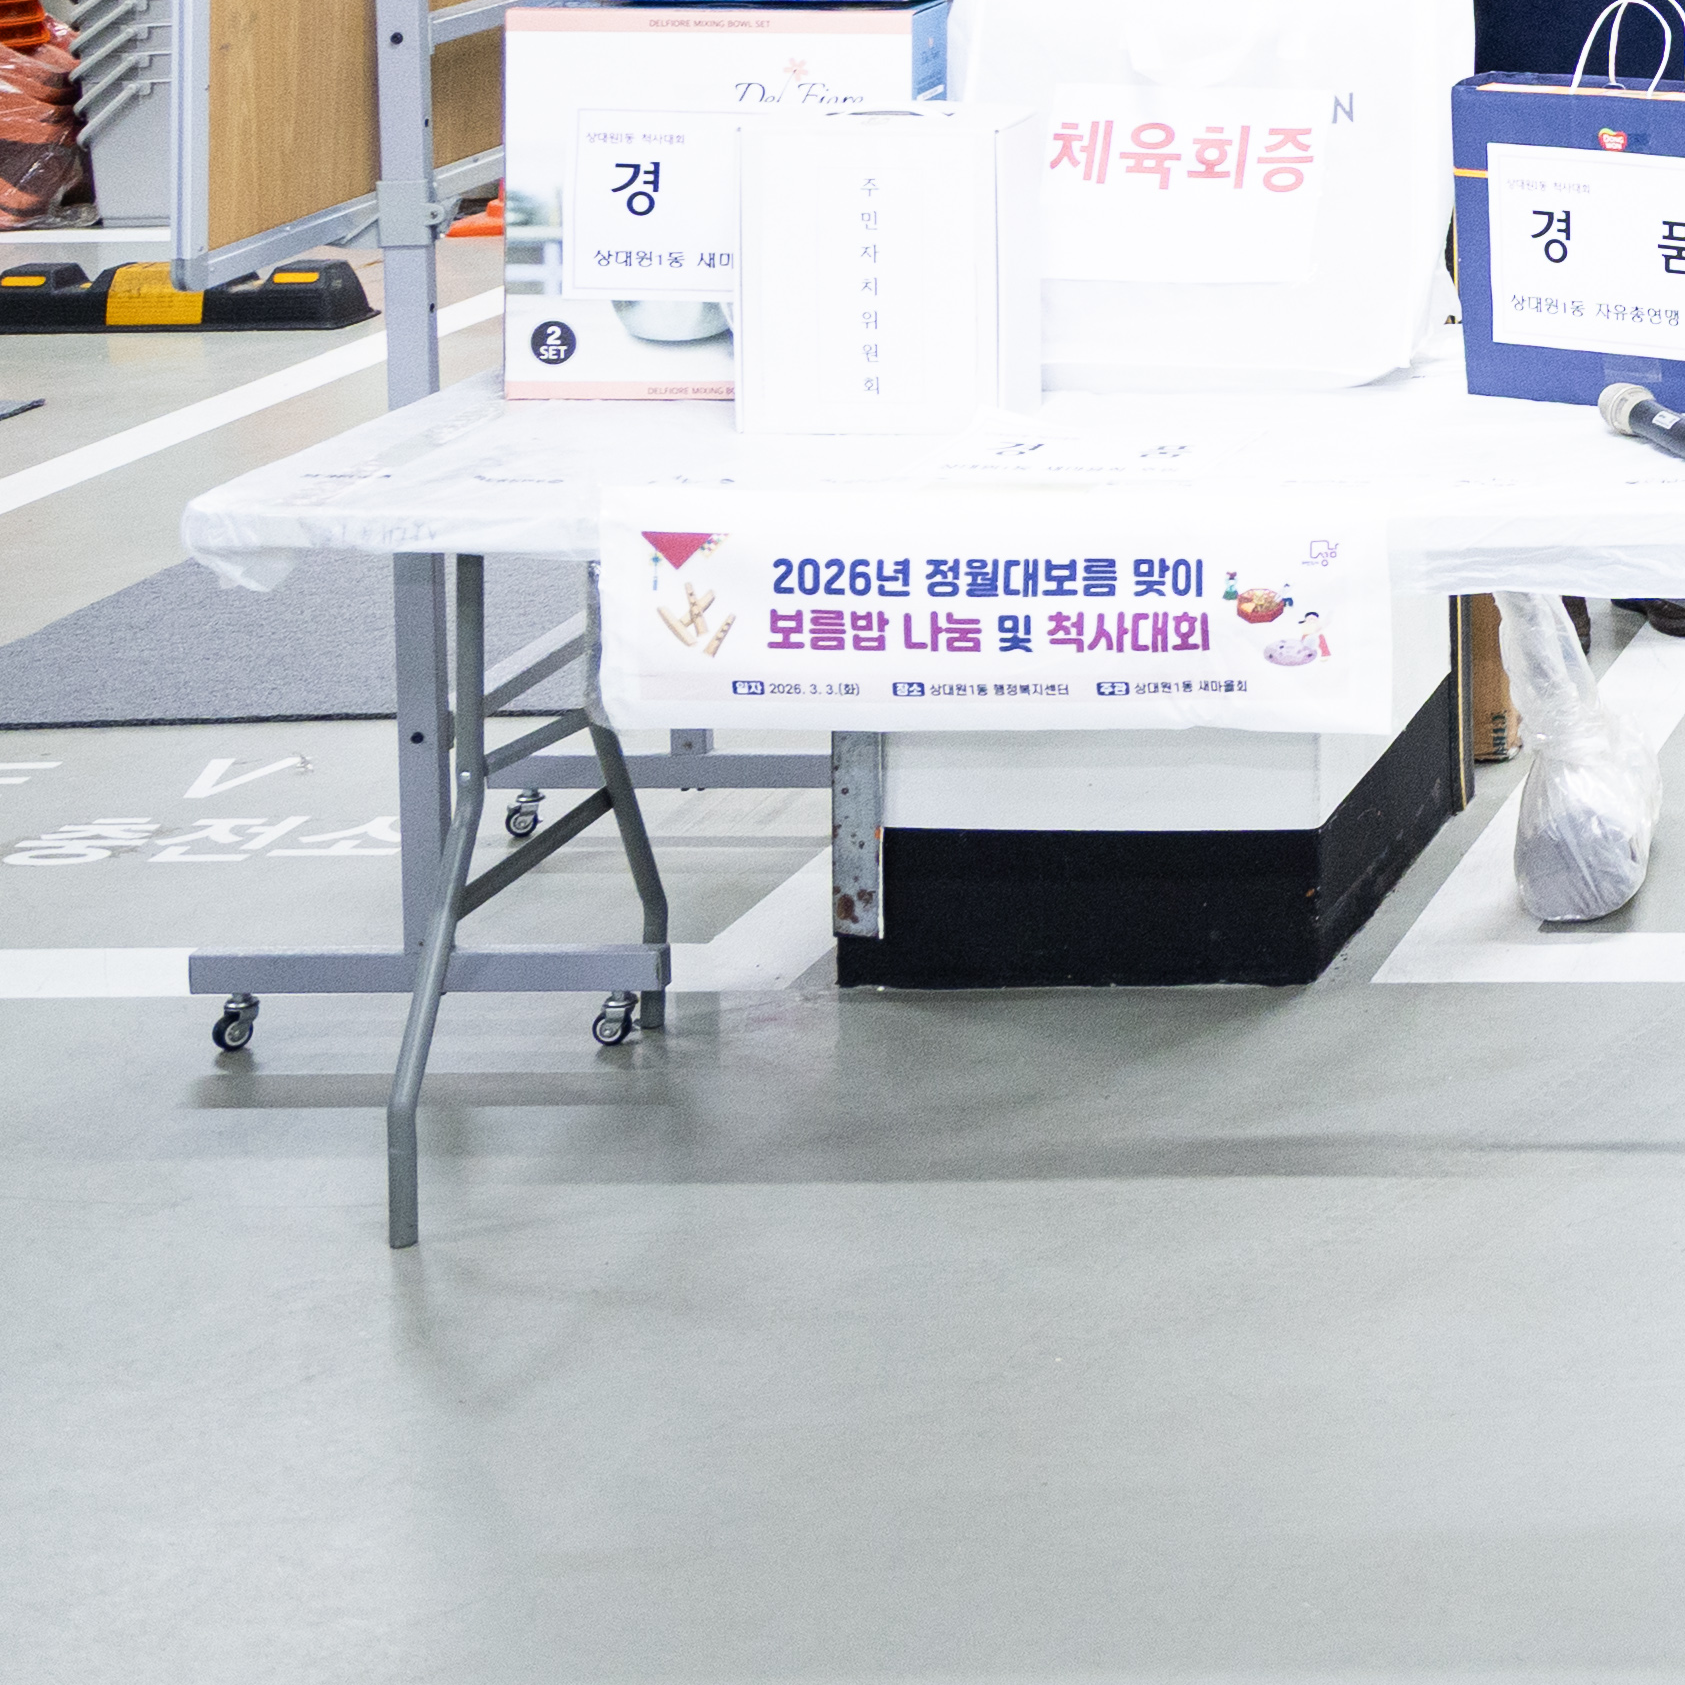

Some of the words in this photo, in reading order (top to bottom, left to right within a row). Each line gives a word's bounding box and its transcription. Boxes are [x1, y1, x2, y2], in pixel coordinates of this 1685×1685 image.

[649, 19, 691, 28] DELFIORE
[693, 19, 725, 28] MIXING
[727, 19, 753, 28] BOWL
[755, 20, 771, 28] SET
[1049, 120, 1315, 193] 체육회증
[611, 160, 661, 217] 경
[1531, 209, 1571, 264] 경
[594, 249, 686, 269] 상대원1동
[1510, 294, 1586, 318] 상대원1동
[546, 325, 562, 345] 2
[539, 345, 568, 360] SET
[772, 557, 912, 599] 2026년
[924, 556, 1119, 599] 정월대보름
[1132, 556, 1205, 599] 맞이
[766, 608, 889, 654] 보름밥
[903, 608, 983, 654] 나눔
[998, 610, 1034, 655] 및
[1046, 609, 1212, 654] 척사대회
[769, 682, 806, 695] 2026.
[929, 683, 989, 696] 상대원1동
[993, 683, 1070, 697] 행정복지센터
[1134, 680, 1193, 695] 상대원1동
[1197, 679, 1248, 694] 새마을회
